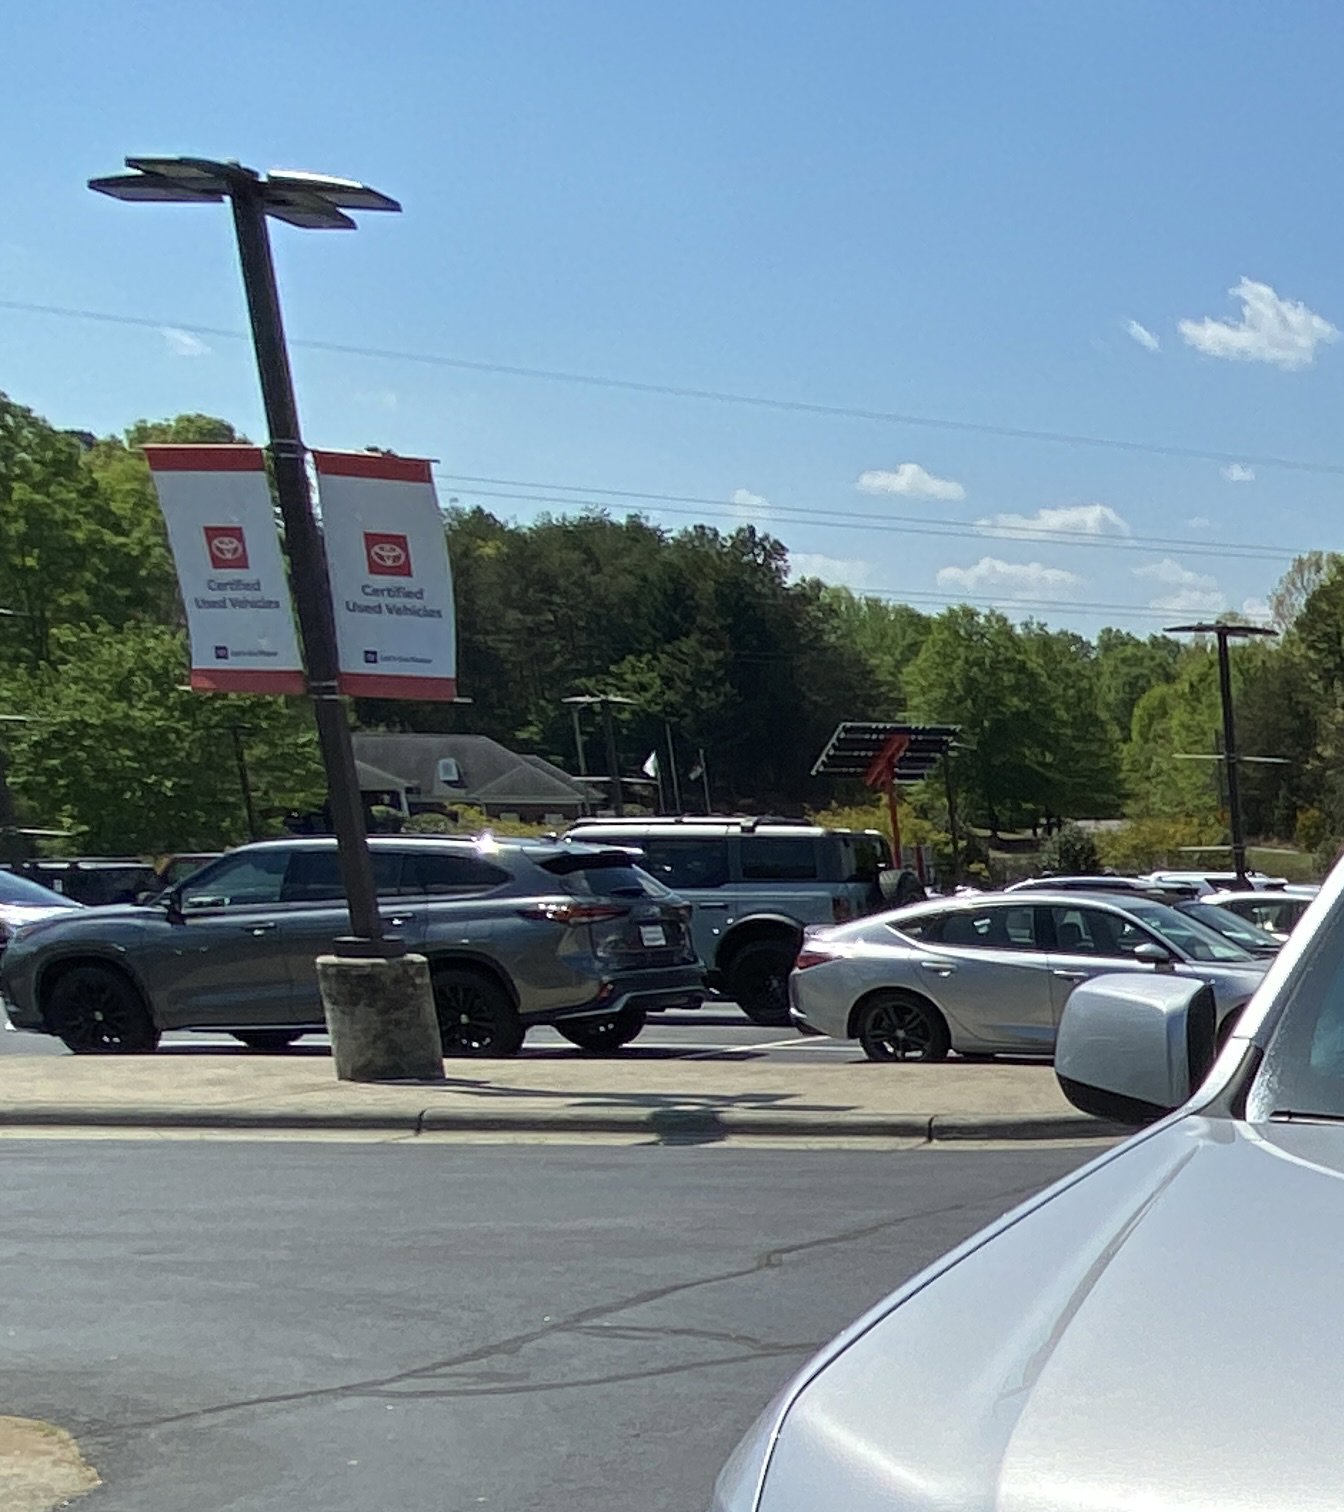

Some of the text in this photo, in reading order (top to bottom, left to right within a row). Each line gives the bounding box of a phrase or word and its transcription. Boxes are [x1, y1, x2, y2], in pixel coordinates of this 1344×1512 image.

[361, 585, 425, 600] Certified
[195, 597, 227, 609] Used
[345, 601, 443, 618] Used Vehicles
